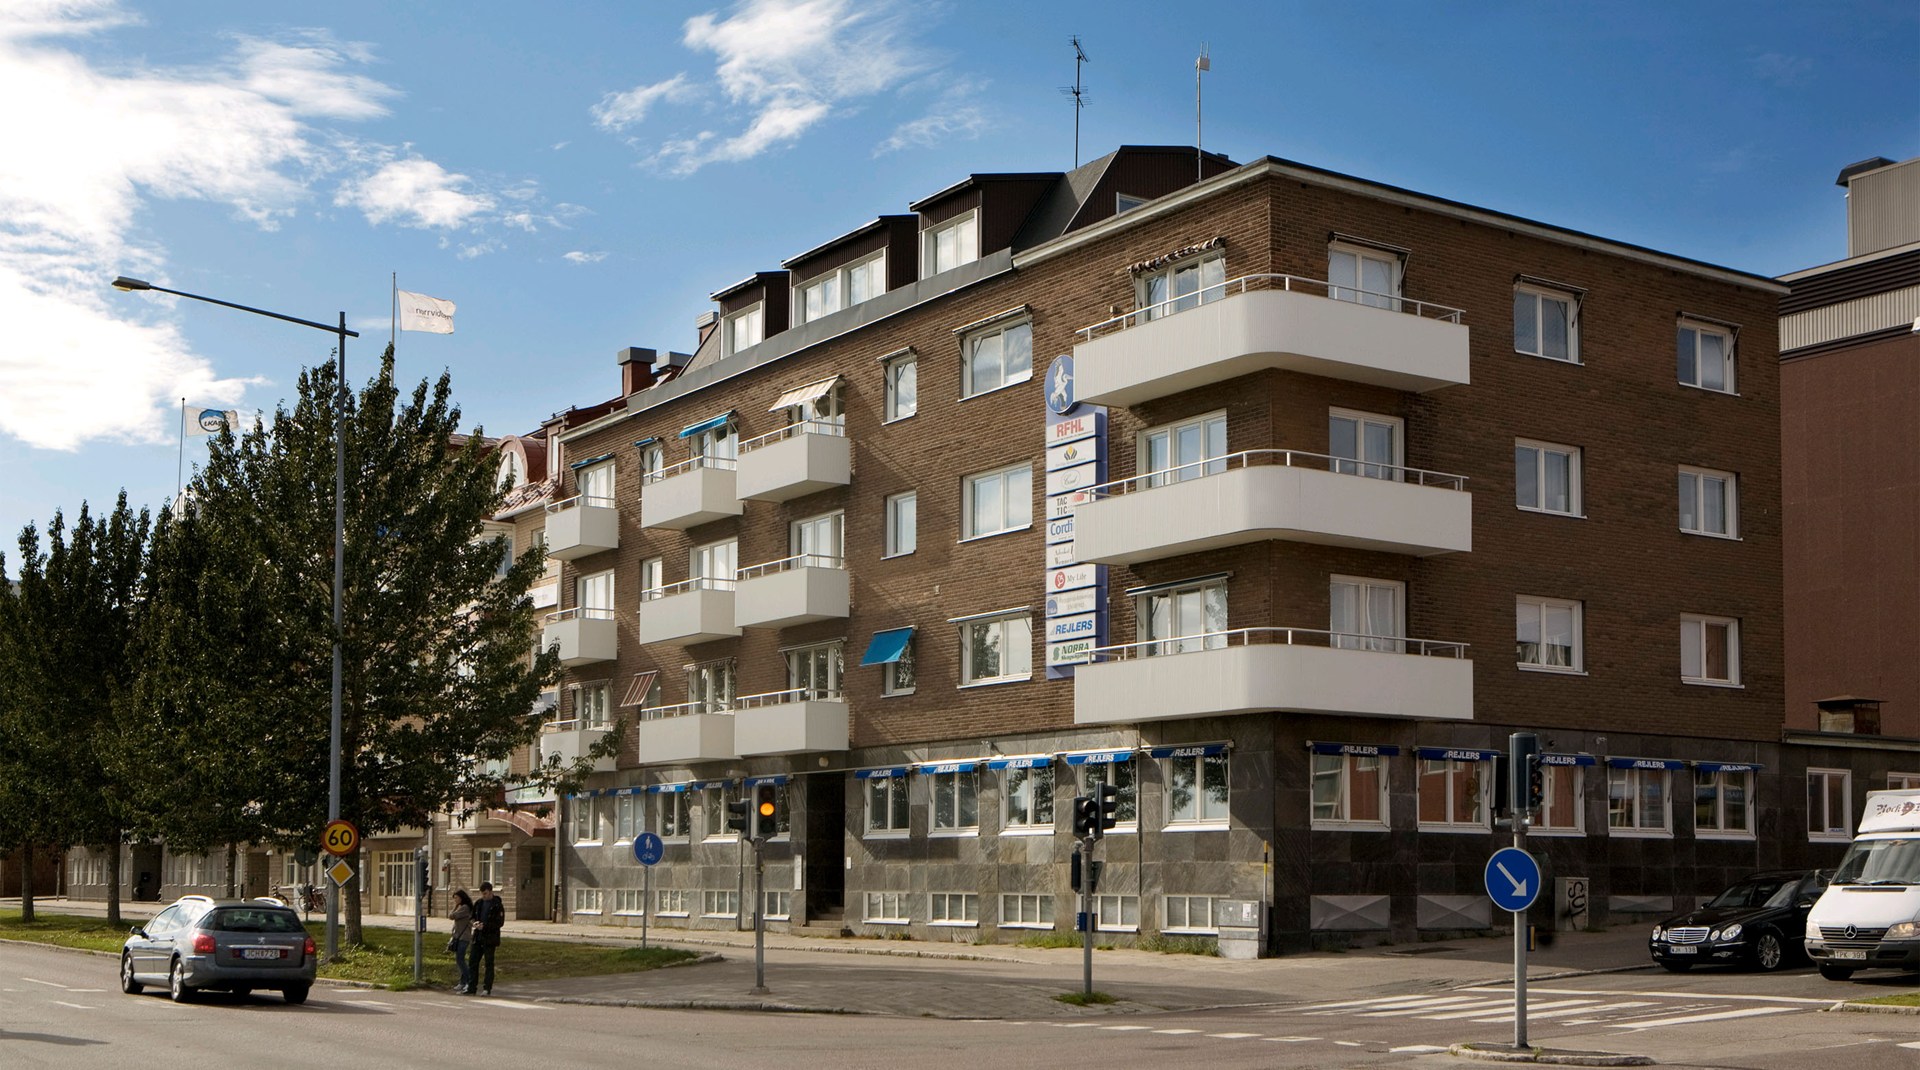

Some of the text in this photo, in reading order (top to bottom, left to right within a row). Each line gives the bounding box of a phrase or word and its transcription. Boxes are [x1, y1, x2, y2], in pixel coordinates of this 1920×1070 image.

[1056, 418, 1084, 438] RFHL
[1056, 497, 1068, 506] TAC
[1056, 506, 1068, 515] TIC
[1056, 619, 1093, 635] REJLERS
[1061, 642, 1089, 655] NORRA
[1175, 747, 1205, 757] REJLERS
[1344, 745, 1378, 755] REJLERS
[1447, 750, 1480, 760] REJLERS
[1008, 759, 1033, 768] REJLERS
[1088, 754, 1115, 763] REJLERS
[1545, 756, 1576, 765] REJLERS
[1637, 760, 1665, 769] REJLERS
[328, 829, 352, 846] 60
